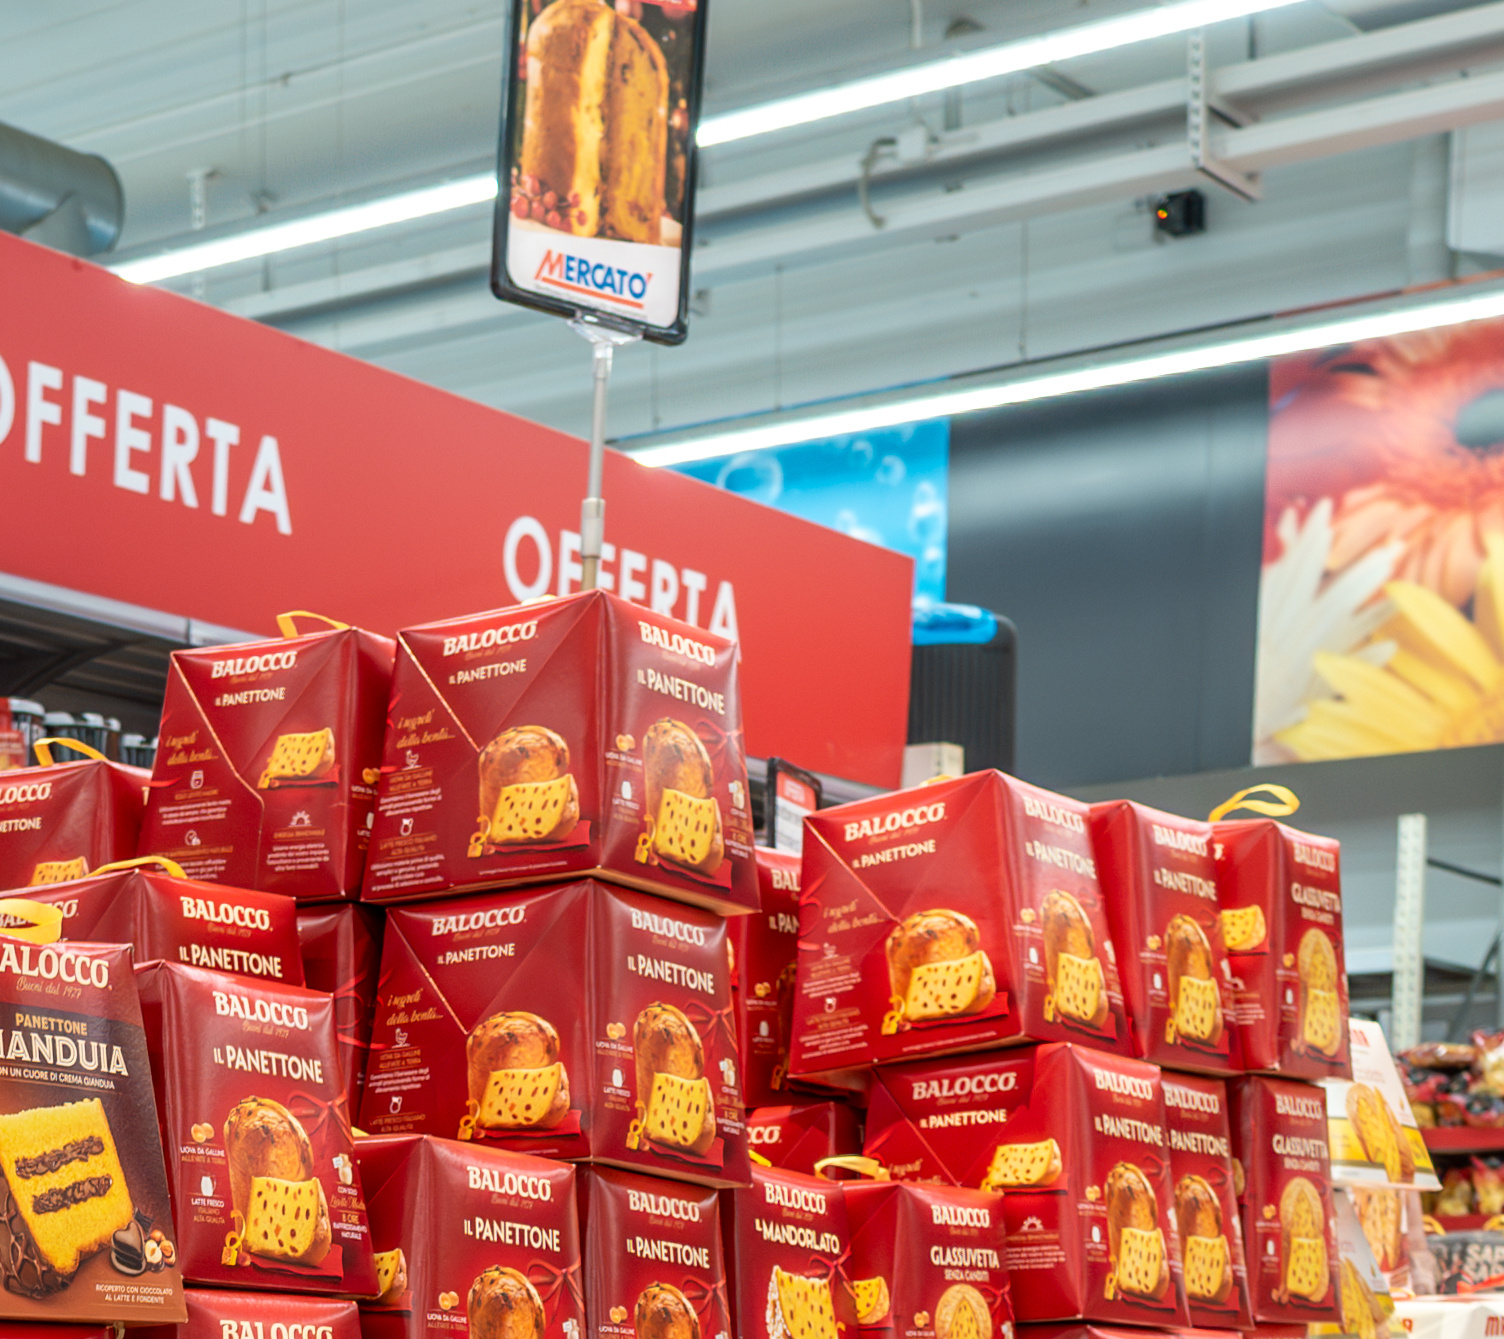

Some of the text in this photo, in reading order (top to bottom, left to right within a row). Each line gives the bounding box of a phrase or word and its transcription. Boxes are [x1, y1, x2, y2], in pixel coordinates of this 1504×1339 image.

[443, 621, 538, 656] BALOCCO
[457, 659, 526, 685] PANETTONE
[15, 1013, 88, 1036] PANETTONE
[213, 991, 309, 1030] BALOCCO
[9, 1067, 21, 1078] UN
[23, 1069, 47, 1081] CUORE
[49, 1072, 57, 1082] DI
[59, 1073, 82, 1085] CREMA
[84, 1076, 114, 1090] GIANDUIA
[214, 1045, 323, 1084] IL PANETTONE
